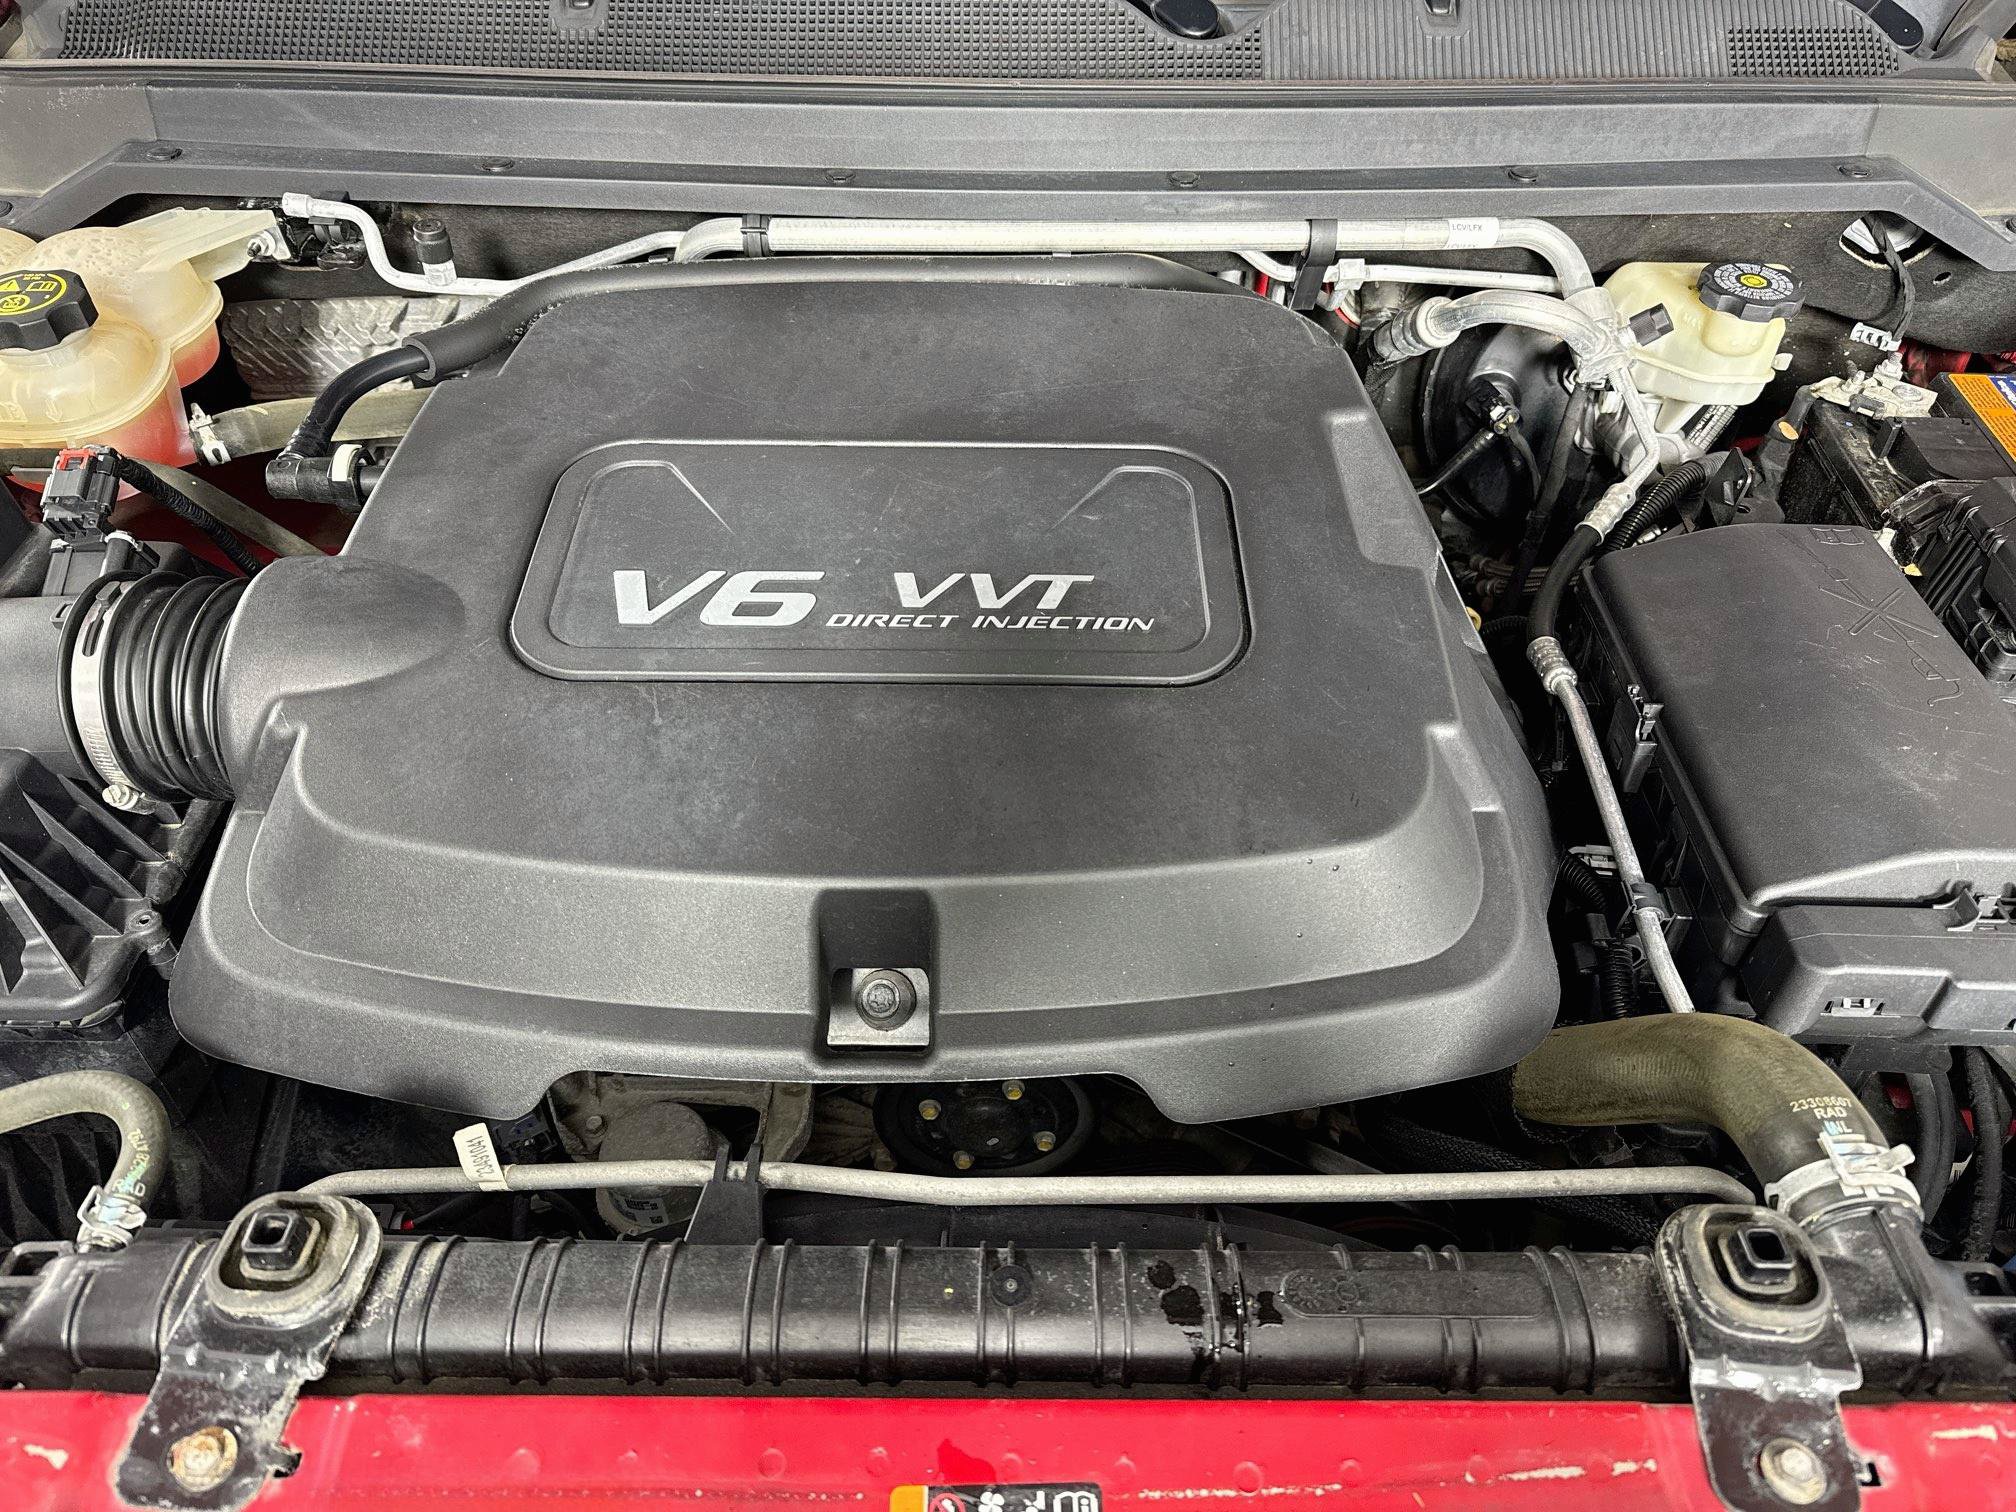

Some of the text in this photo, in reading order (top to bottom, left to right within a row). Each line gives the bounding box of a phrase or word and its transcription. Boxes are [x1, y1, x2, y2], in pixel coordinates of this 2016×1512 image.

[613, 570, 1095, 627] V6 VVT
[825, 614, 1155, 632] DIRECT INJECTION
[1813, 1106, 1848, 1120] RAD
